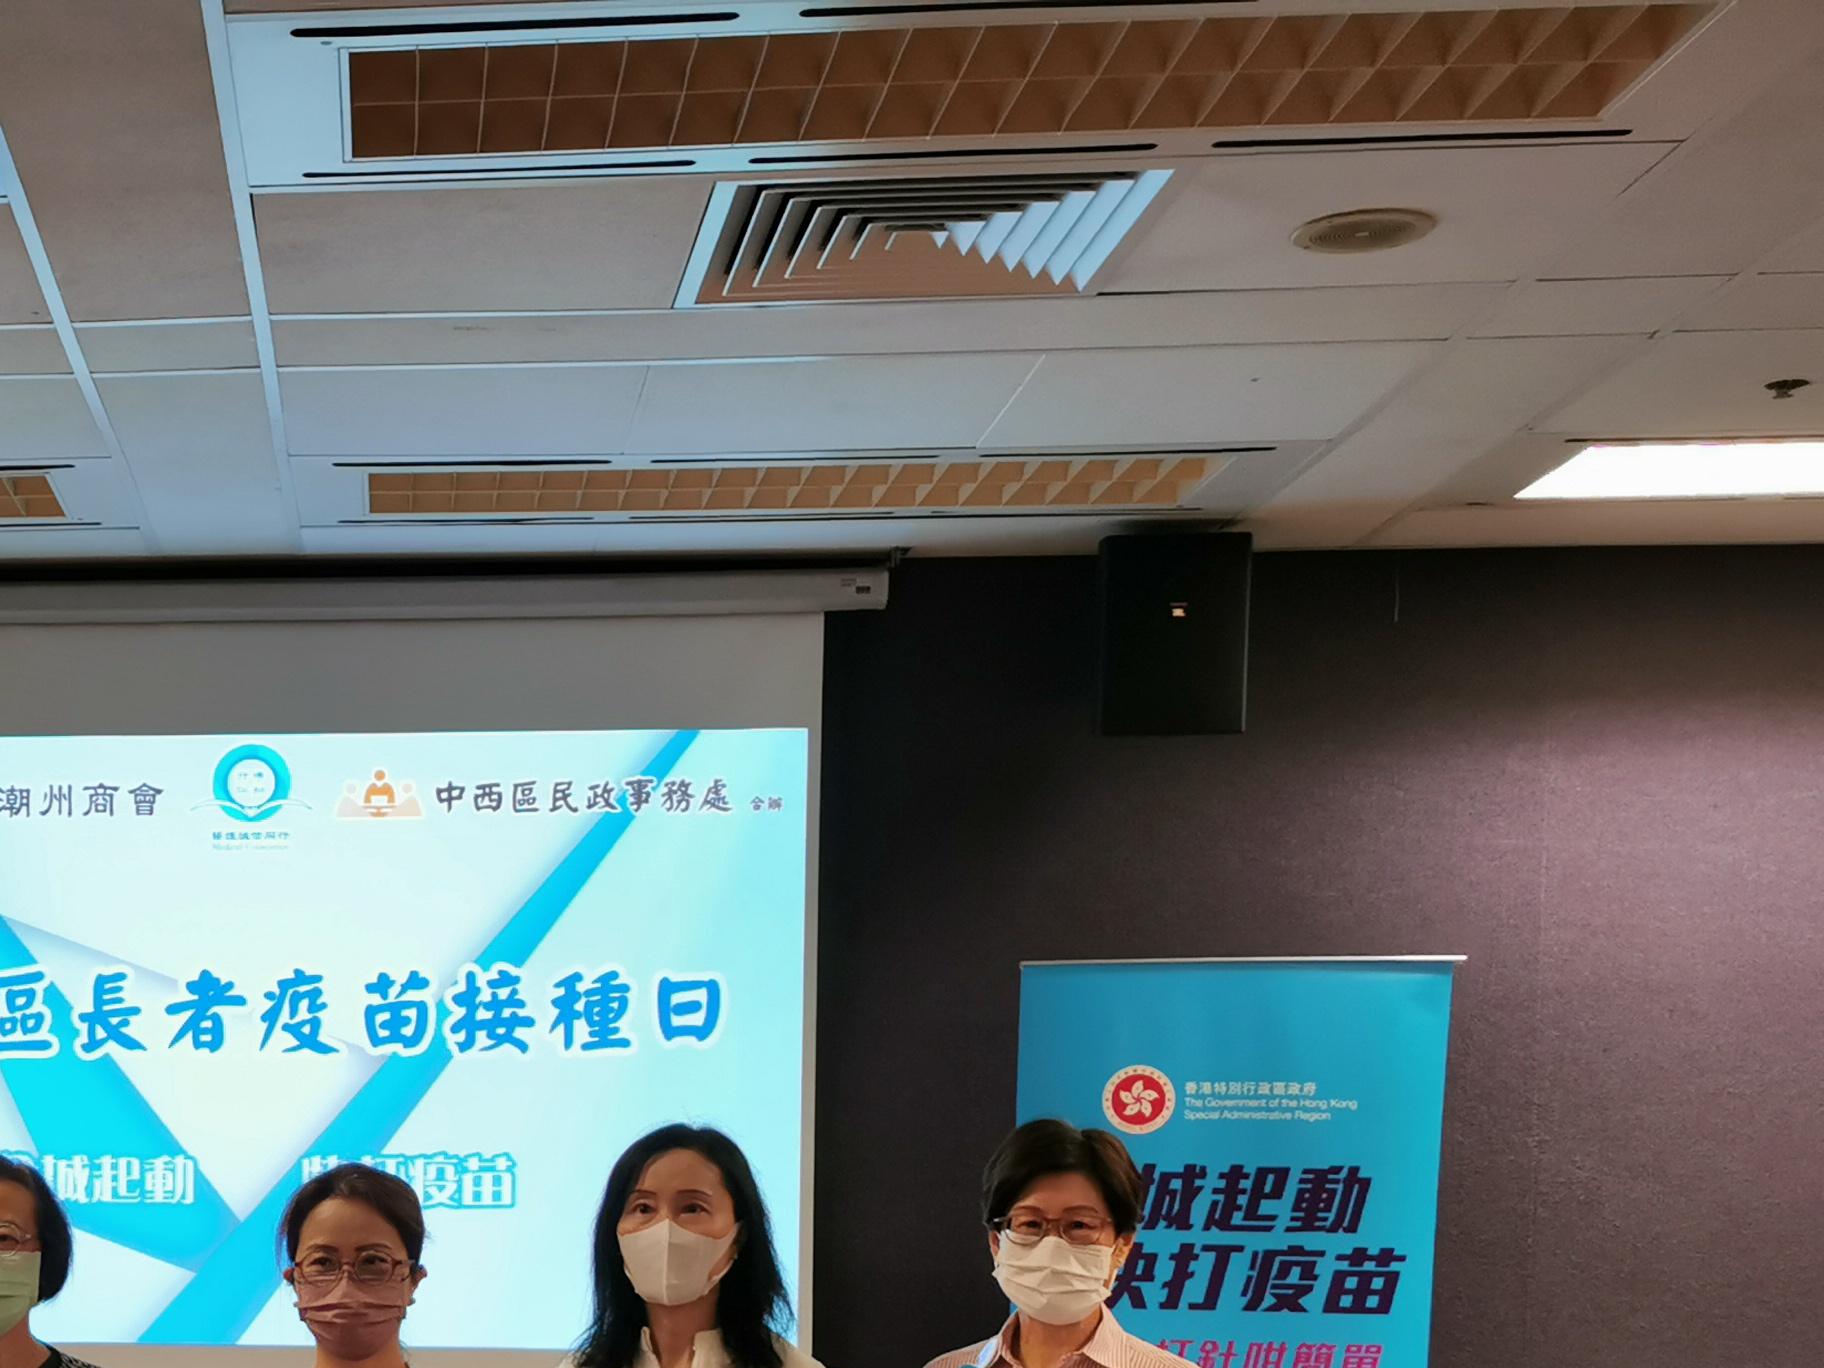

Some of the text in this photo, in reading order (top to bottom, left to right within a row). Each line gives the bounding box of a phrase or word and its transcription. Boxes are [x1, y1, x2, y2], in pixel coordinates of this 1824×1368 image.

[435, 778, 733, 814] 中西區民政事務處
[1205, 1097, 1267, 1108] Government
[1300, 1099, 1327, 1110] Hong
[1330, 1099, 1358, 1111] Kong
[1184, 1110, 1331, 1122] Special Administrative Region
